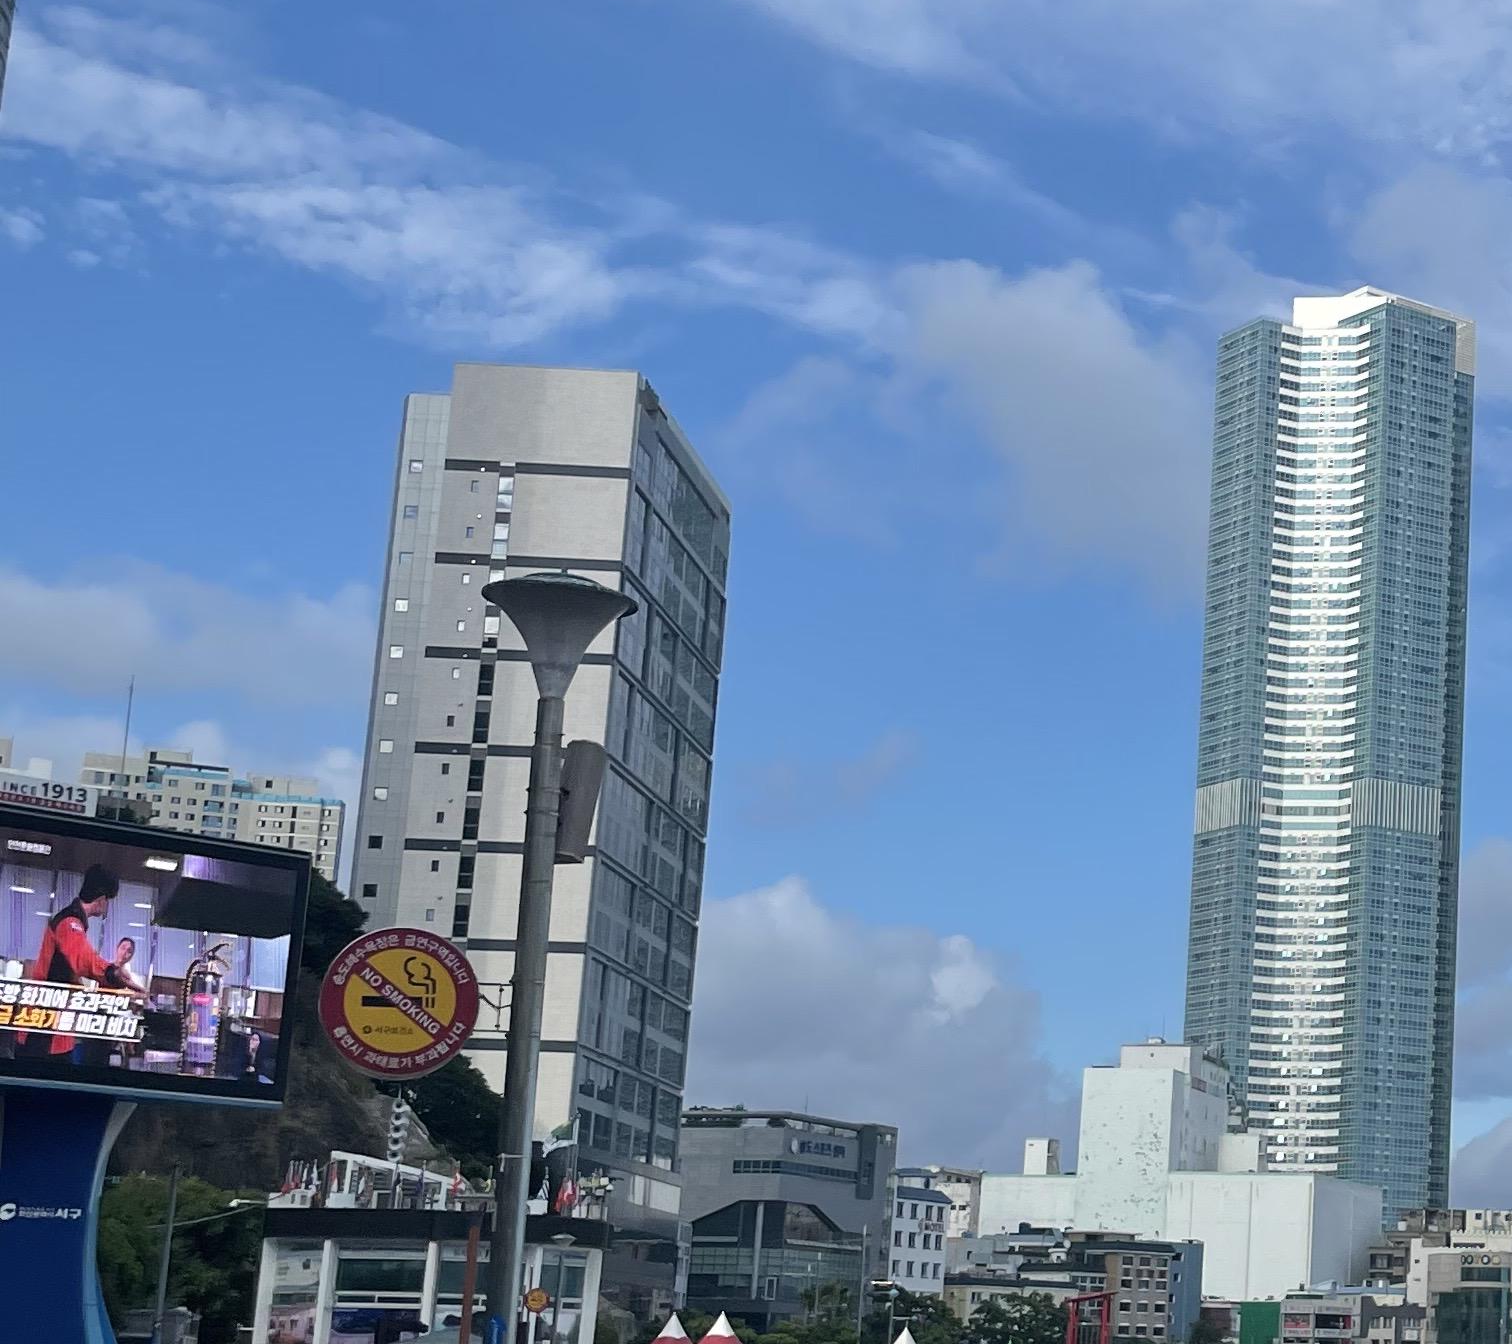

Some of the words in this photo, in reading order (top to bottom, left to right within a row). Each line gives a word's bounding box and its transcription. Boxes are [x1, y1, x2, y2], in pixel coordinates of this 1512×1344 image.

[41, 782, 87, 803] 1913
[404, 934, 470, 985] 금연구역입니다
[0, 982, 20, 1004] 방
[20, 986, 69, 1009] 화재에
[67, 991, 133, 1016] 효과적인
[360, 967, 382, 987] NO
[381, 985, 441, 1035] SMOKING
[13, 1006, 75, 1031] 소화기를
[76, 1013, 107, 1034] 미리
[106, 1015, 138, 1037] 비치
[334, 1026, 365, 1056] 흡연시
[363, 1053, 412, 1069] 과태료가
[415, 1022, 466, 1066] 부과됩니다
[55, 1208, 82, 1219] 서구
